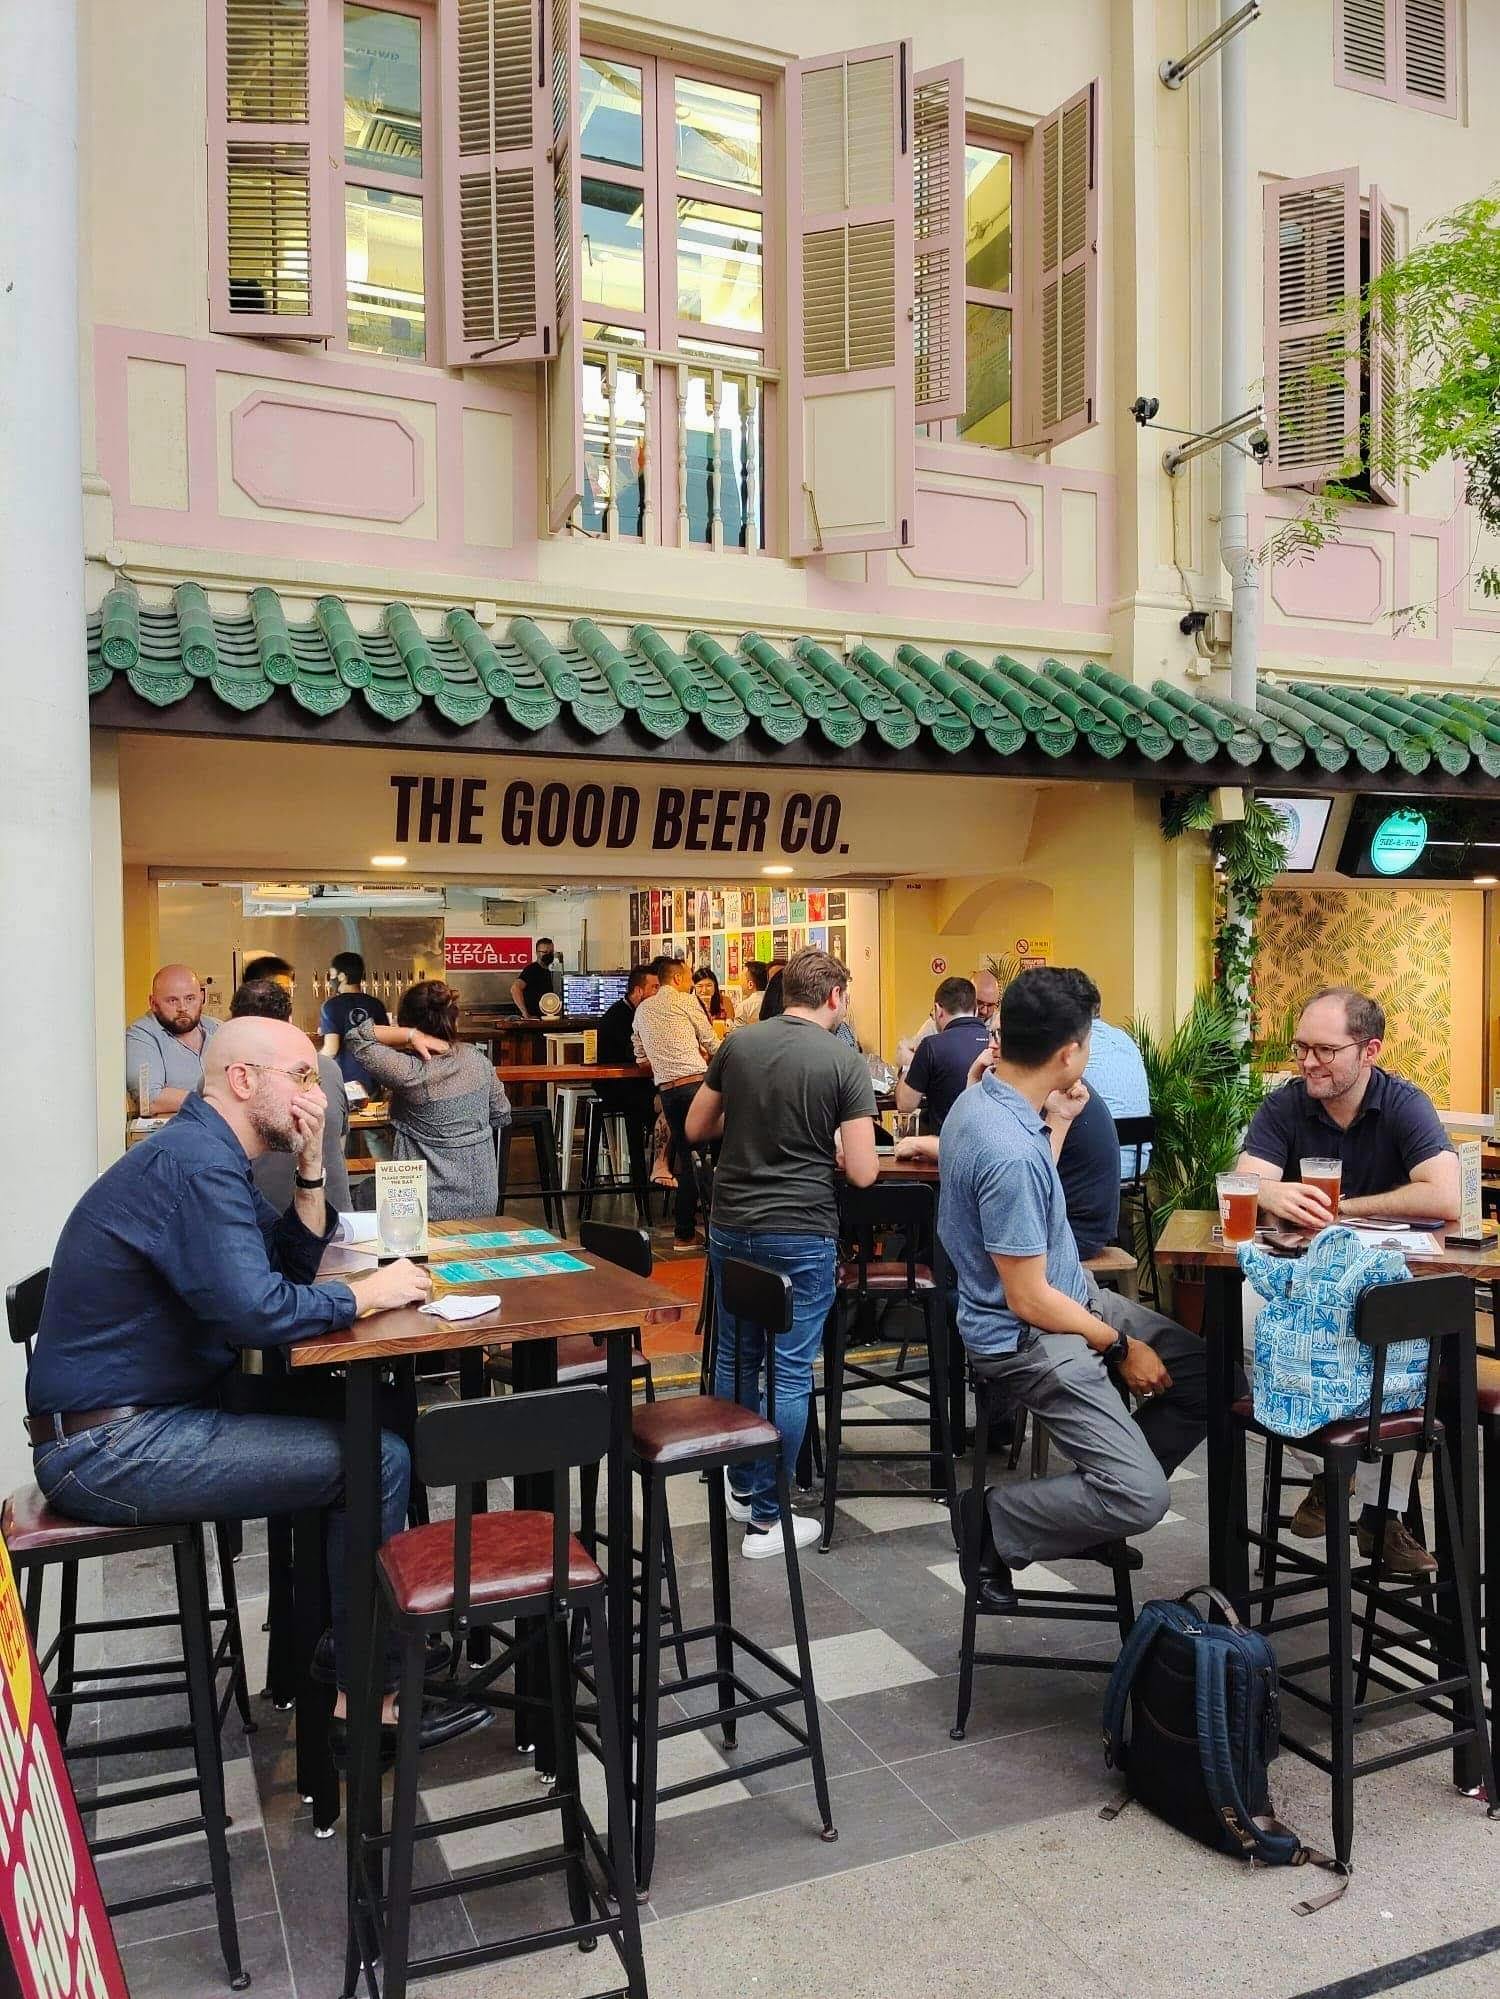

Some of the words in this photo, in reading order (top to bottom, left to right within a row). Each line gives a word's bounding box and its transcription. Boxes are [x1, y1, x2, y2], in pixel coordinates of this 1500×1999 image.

[390, 775, 487, 844] THE
[501, 778, 640, 848] GOOD
[652, 787, 771, 852] BEER
[780, 793, 850, 855] CO.
[444, 943, 495, 954] PIZZA
[444, 953, 528, 964] REPUBLIC
[380, 1164, 424, 1173] WELCOME
